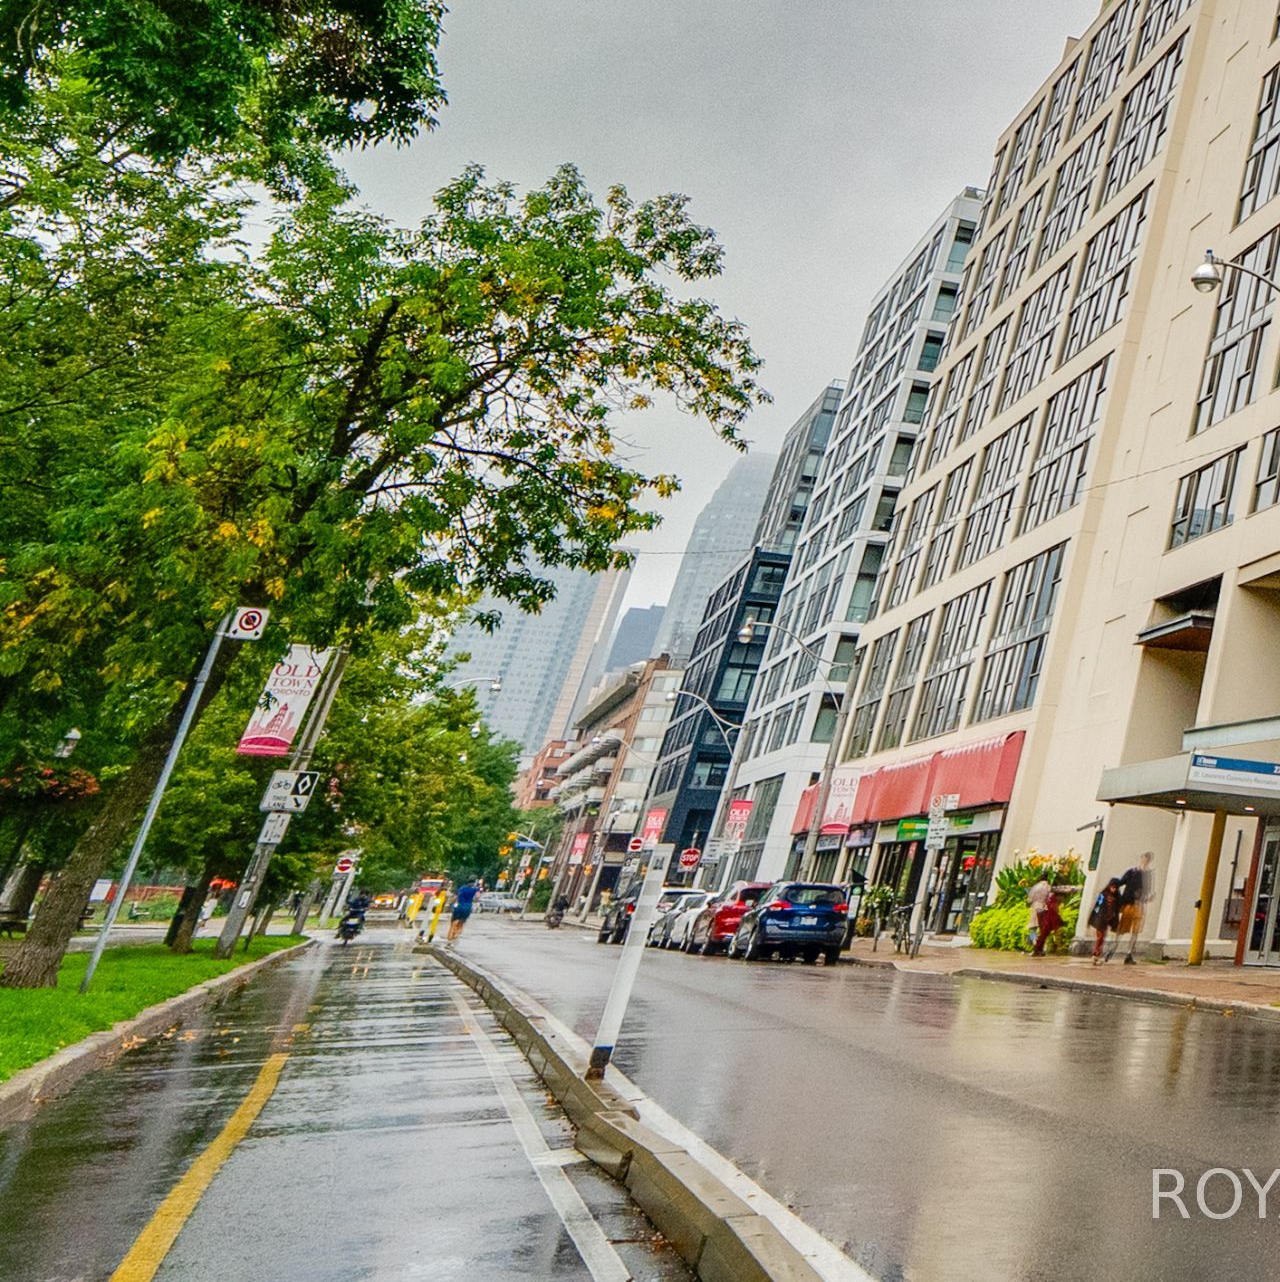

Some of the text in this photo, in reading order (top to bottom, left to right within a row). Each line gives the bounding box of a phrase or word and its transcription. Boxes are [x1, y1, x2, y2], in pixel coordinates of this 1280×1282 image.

[275, 663, 321, 678] OLD
[272, 677, 316, 688] TOWN
[833, 778, 858, 787] OLD
[729, 809, 750, 817] OLD
[681, 854, 699, 863] STOP
